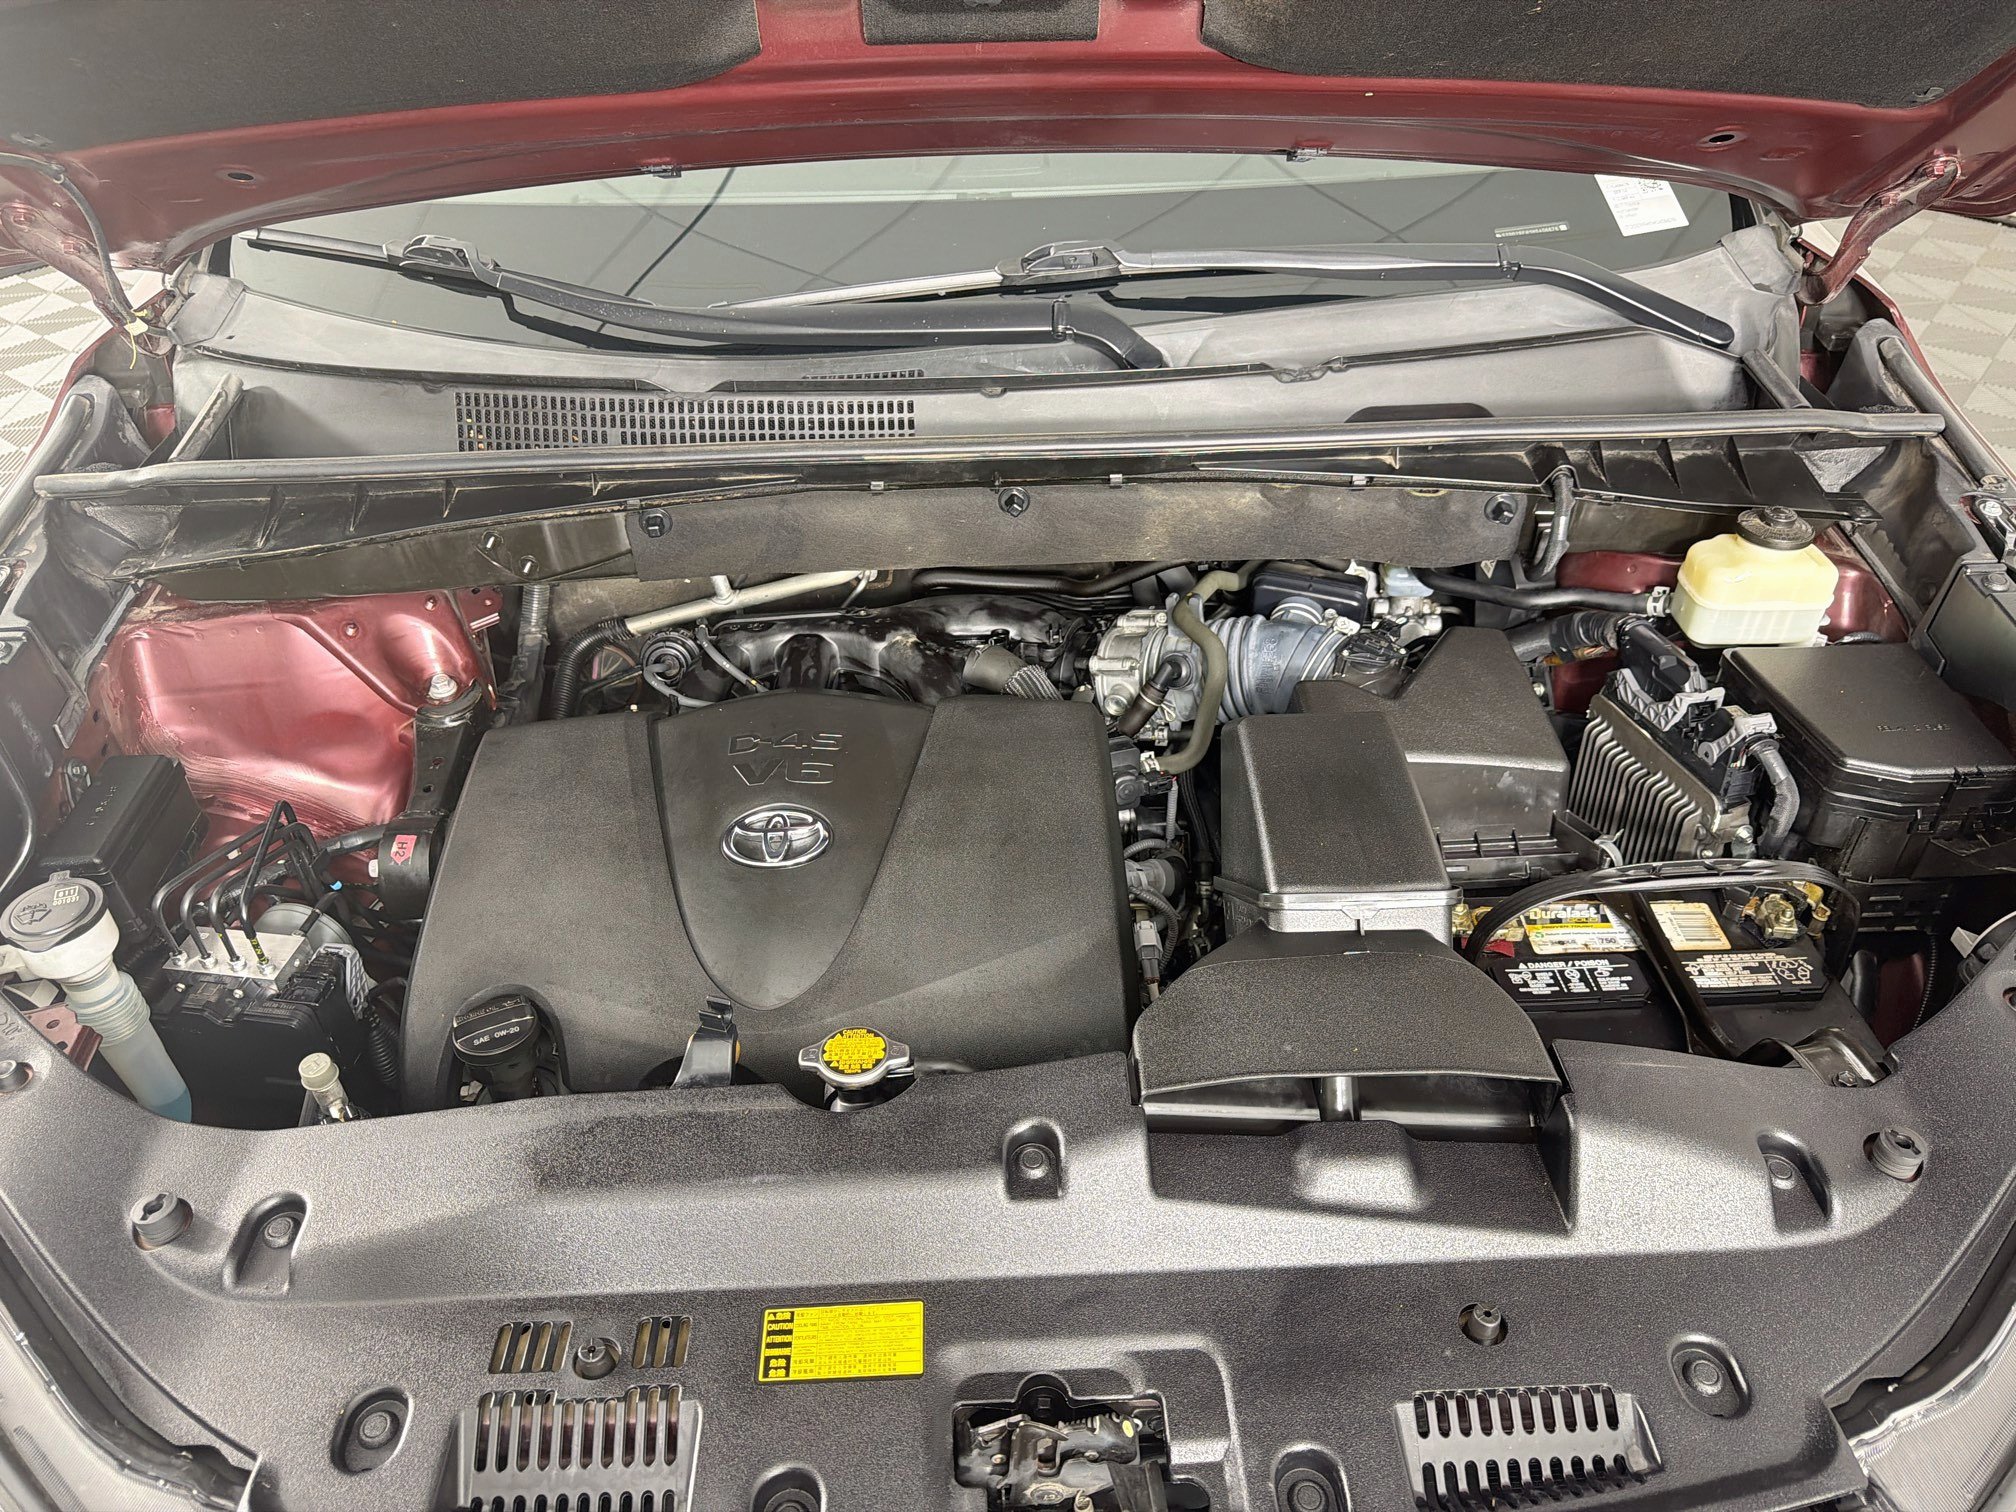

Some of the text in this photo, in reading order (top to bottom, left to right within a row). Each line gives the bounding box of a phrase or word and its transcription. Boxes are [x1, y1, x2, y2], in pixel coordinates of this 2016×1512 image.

[733, 758, 834, 786] V6
[394, 841, 408, 857] H2
[1529, 905, 1599, 920] Duralast
[1599, 937, 1616, 945] 750
[1527, 961, 1566, 969] DANGER
[1574, 959, 1609, 967] POISON
[473, 1026, 520, 1046] SAE 0W-20
[767, 1322, 794, 1331] CAUTION
[766, 1335, 792, 1343] ATTENTION
